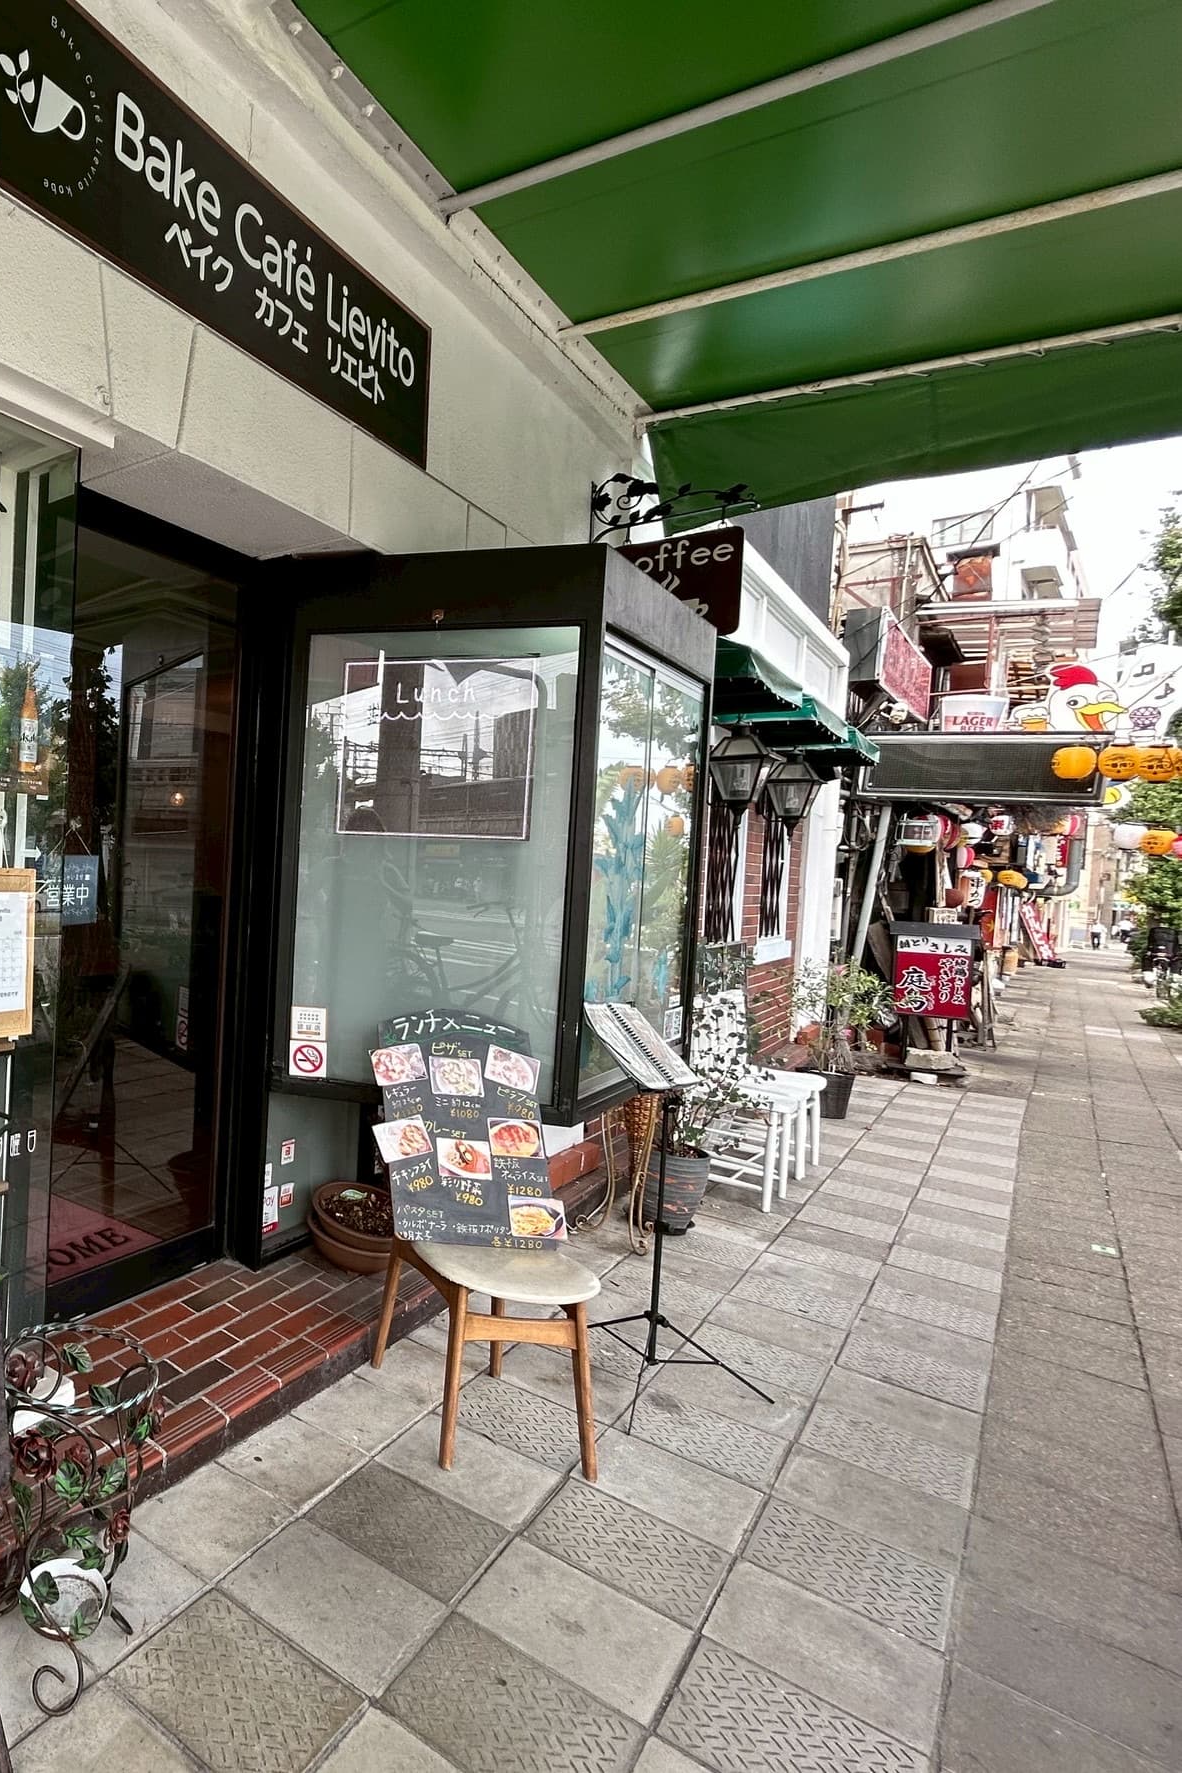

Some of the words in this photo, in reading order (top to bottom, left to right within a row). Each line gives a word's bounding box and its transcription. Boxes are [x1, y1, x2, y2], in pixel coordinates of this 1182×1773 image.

[114, 91, 221, 237] Bake
[234, 202, 316, 312] Café
[326, 272, 415, 387] Lievito
[164, 222, 234, 292] ベイク
[254, 286, 309, 353] カフェ
[326, 337, 386, 405] リエビト
[634, 539, 735, 575] offee
[396, 682, 476, 704] Lunch
[953, 716, 994, 727] LAGER
[46, 883, 89, 907] 営業中
[393, 1009, 516, 1040] ランチメニュー
[406, 1175, 434, 1193] ¥980
[507, 1184, 542, 1197] ¥1280
[455, 1192, 484, 1206] ¥980
